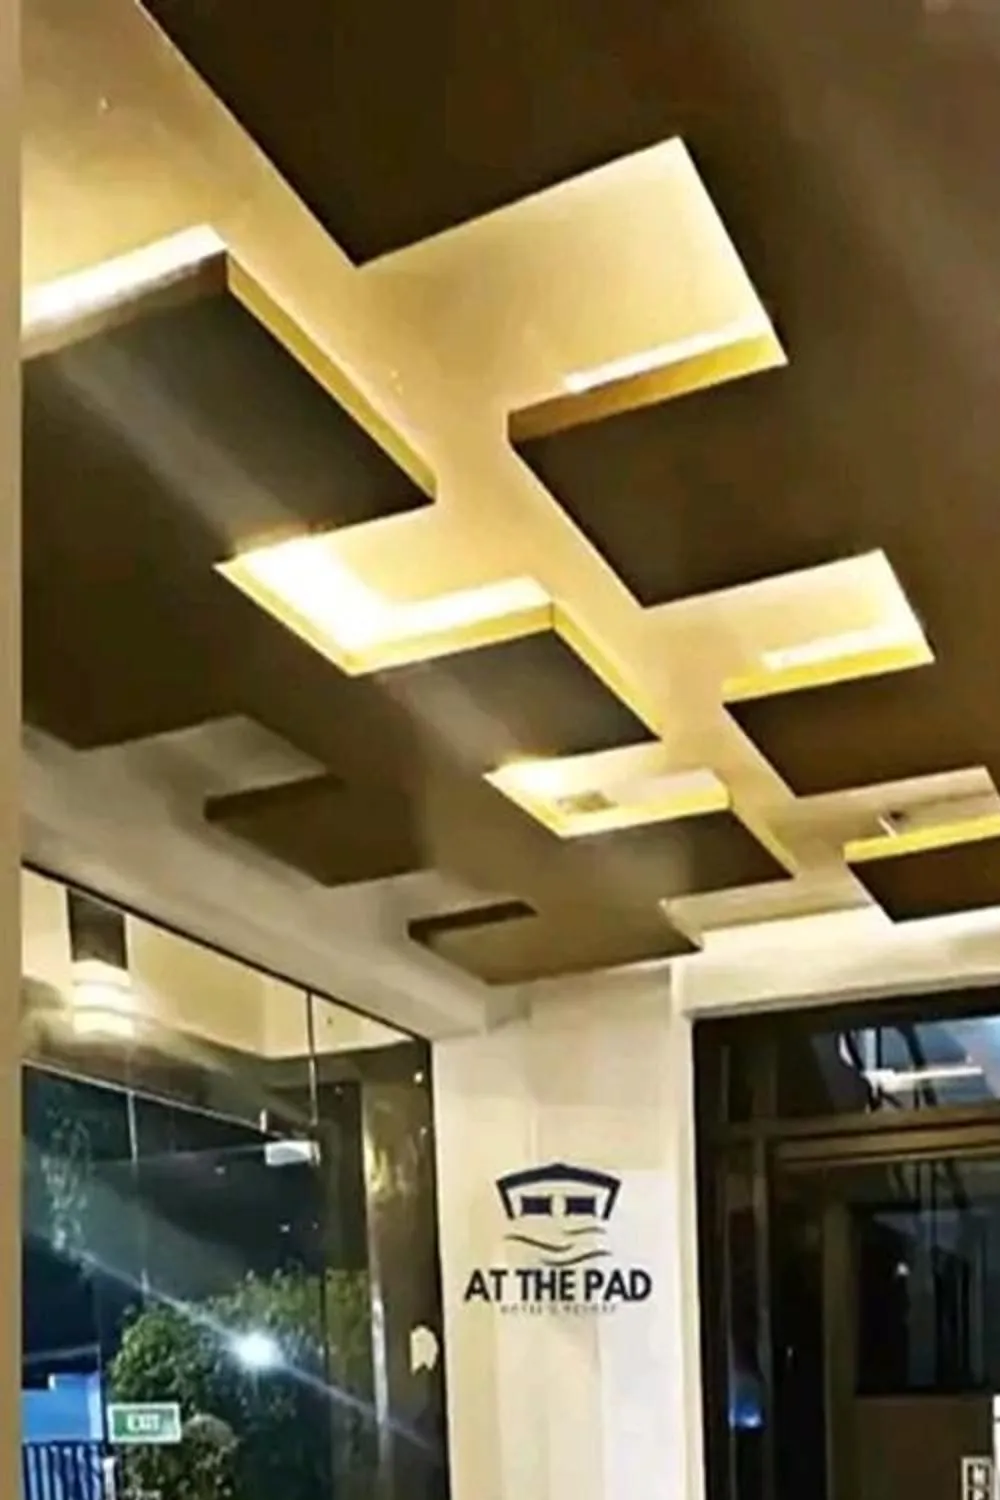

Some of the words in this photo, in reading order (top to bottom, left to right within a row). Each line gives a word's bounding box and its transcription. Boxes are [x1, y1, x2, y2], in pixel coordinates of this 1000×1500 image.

[464, 1269, 507, 1302] AT
[515, 1269, 576, 1302] THE
[584, 1269, 652, 1302] PAD
[126, 1413, 160, 1432] EXIT
